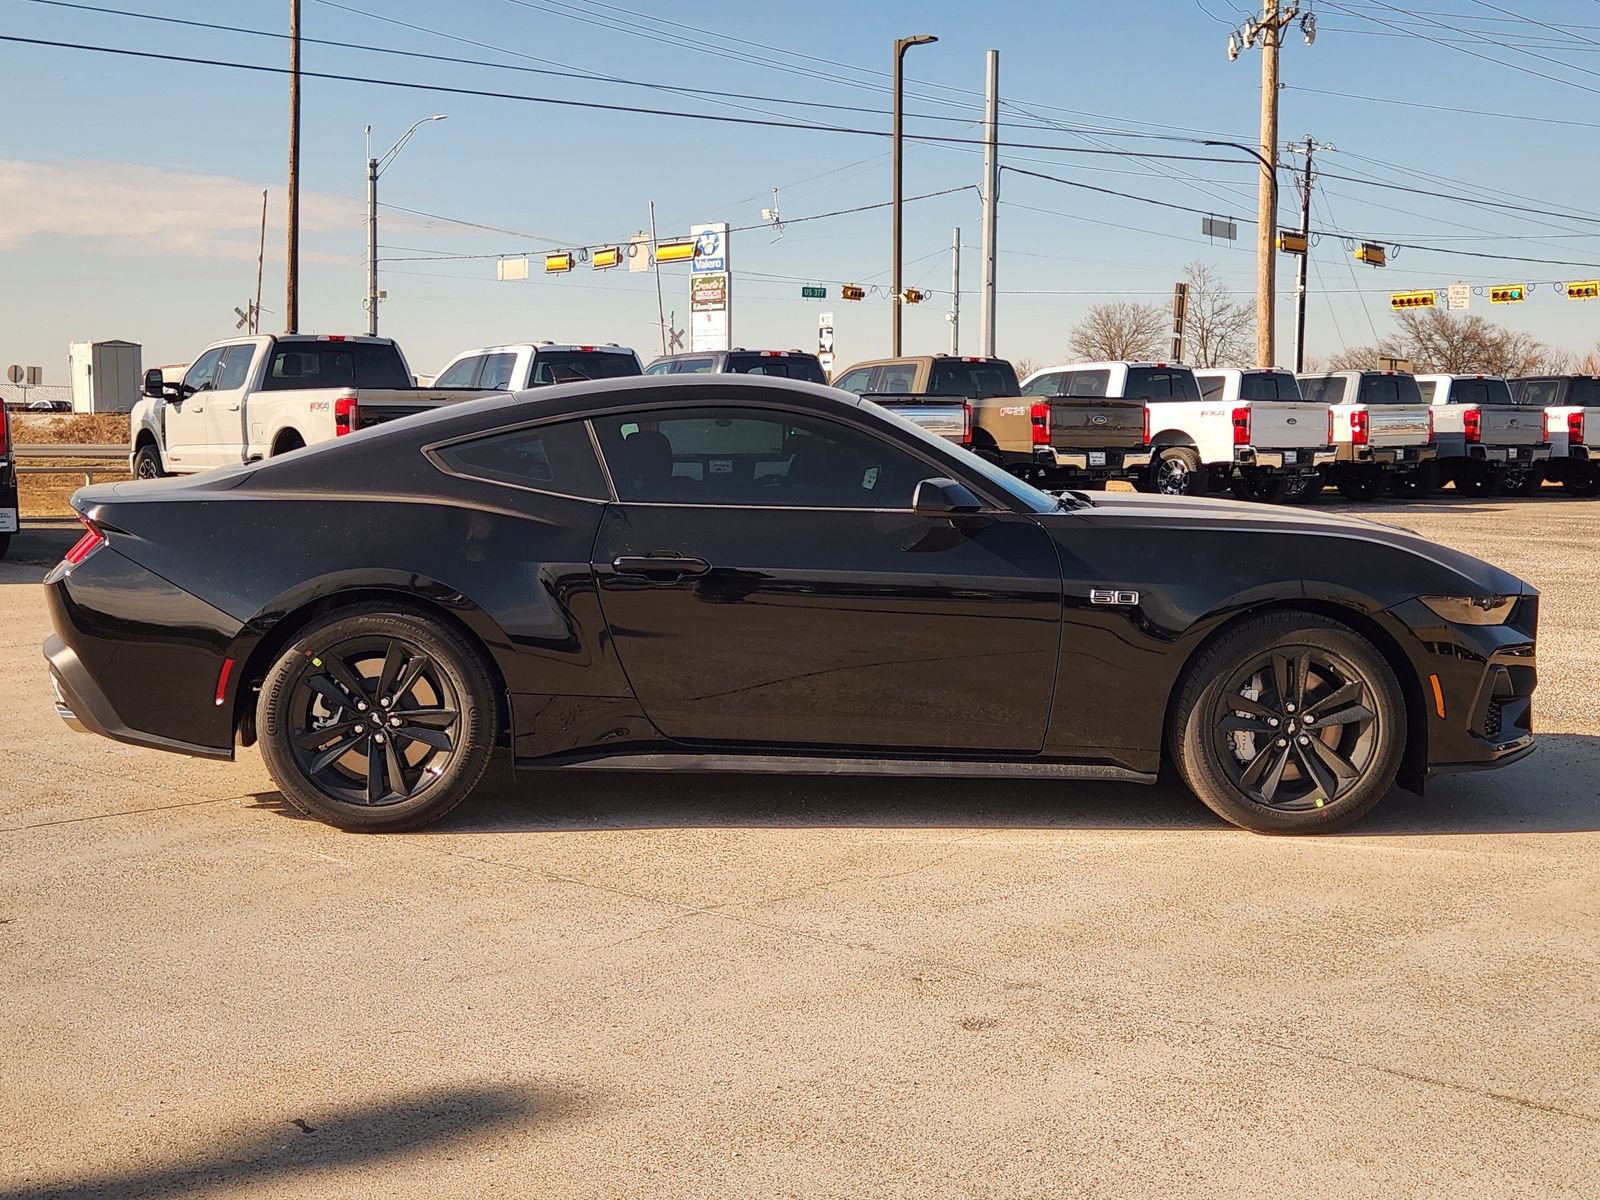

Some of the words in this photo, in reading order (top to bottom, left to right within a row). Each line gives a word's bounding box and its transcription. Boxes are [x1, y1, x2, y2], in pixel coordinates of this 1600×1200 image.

[694, 259, 721, 270] Valero
[804, 288, 812, 296] US
[814, 289, 825, 297] 377
[265, 667, 290, 737] Continental
